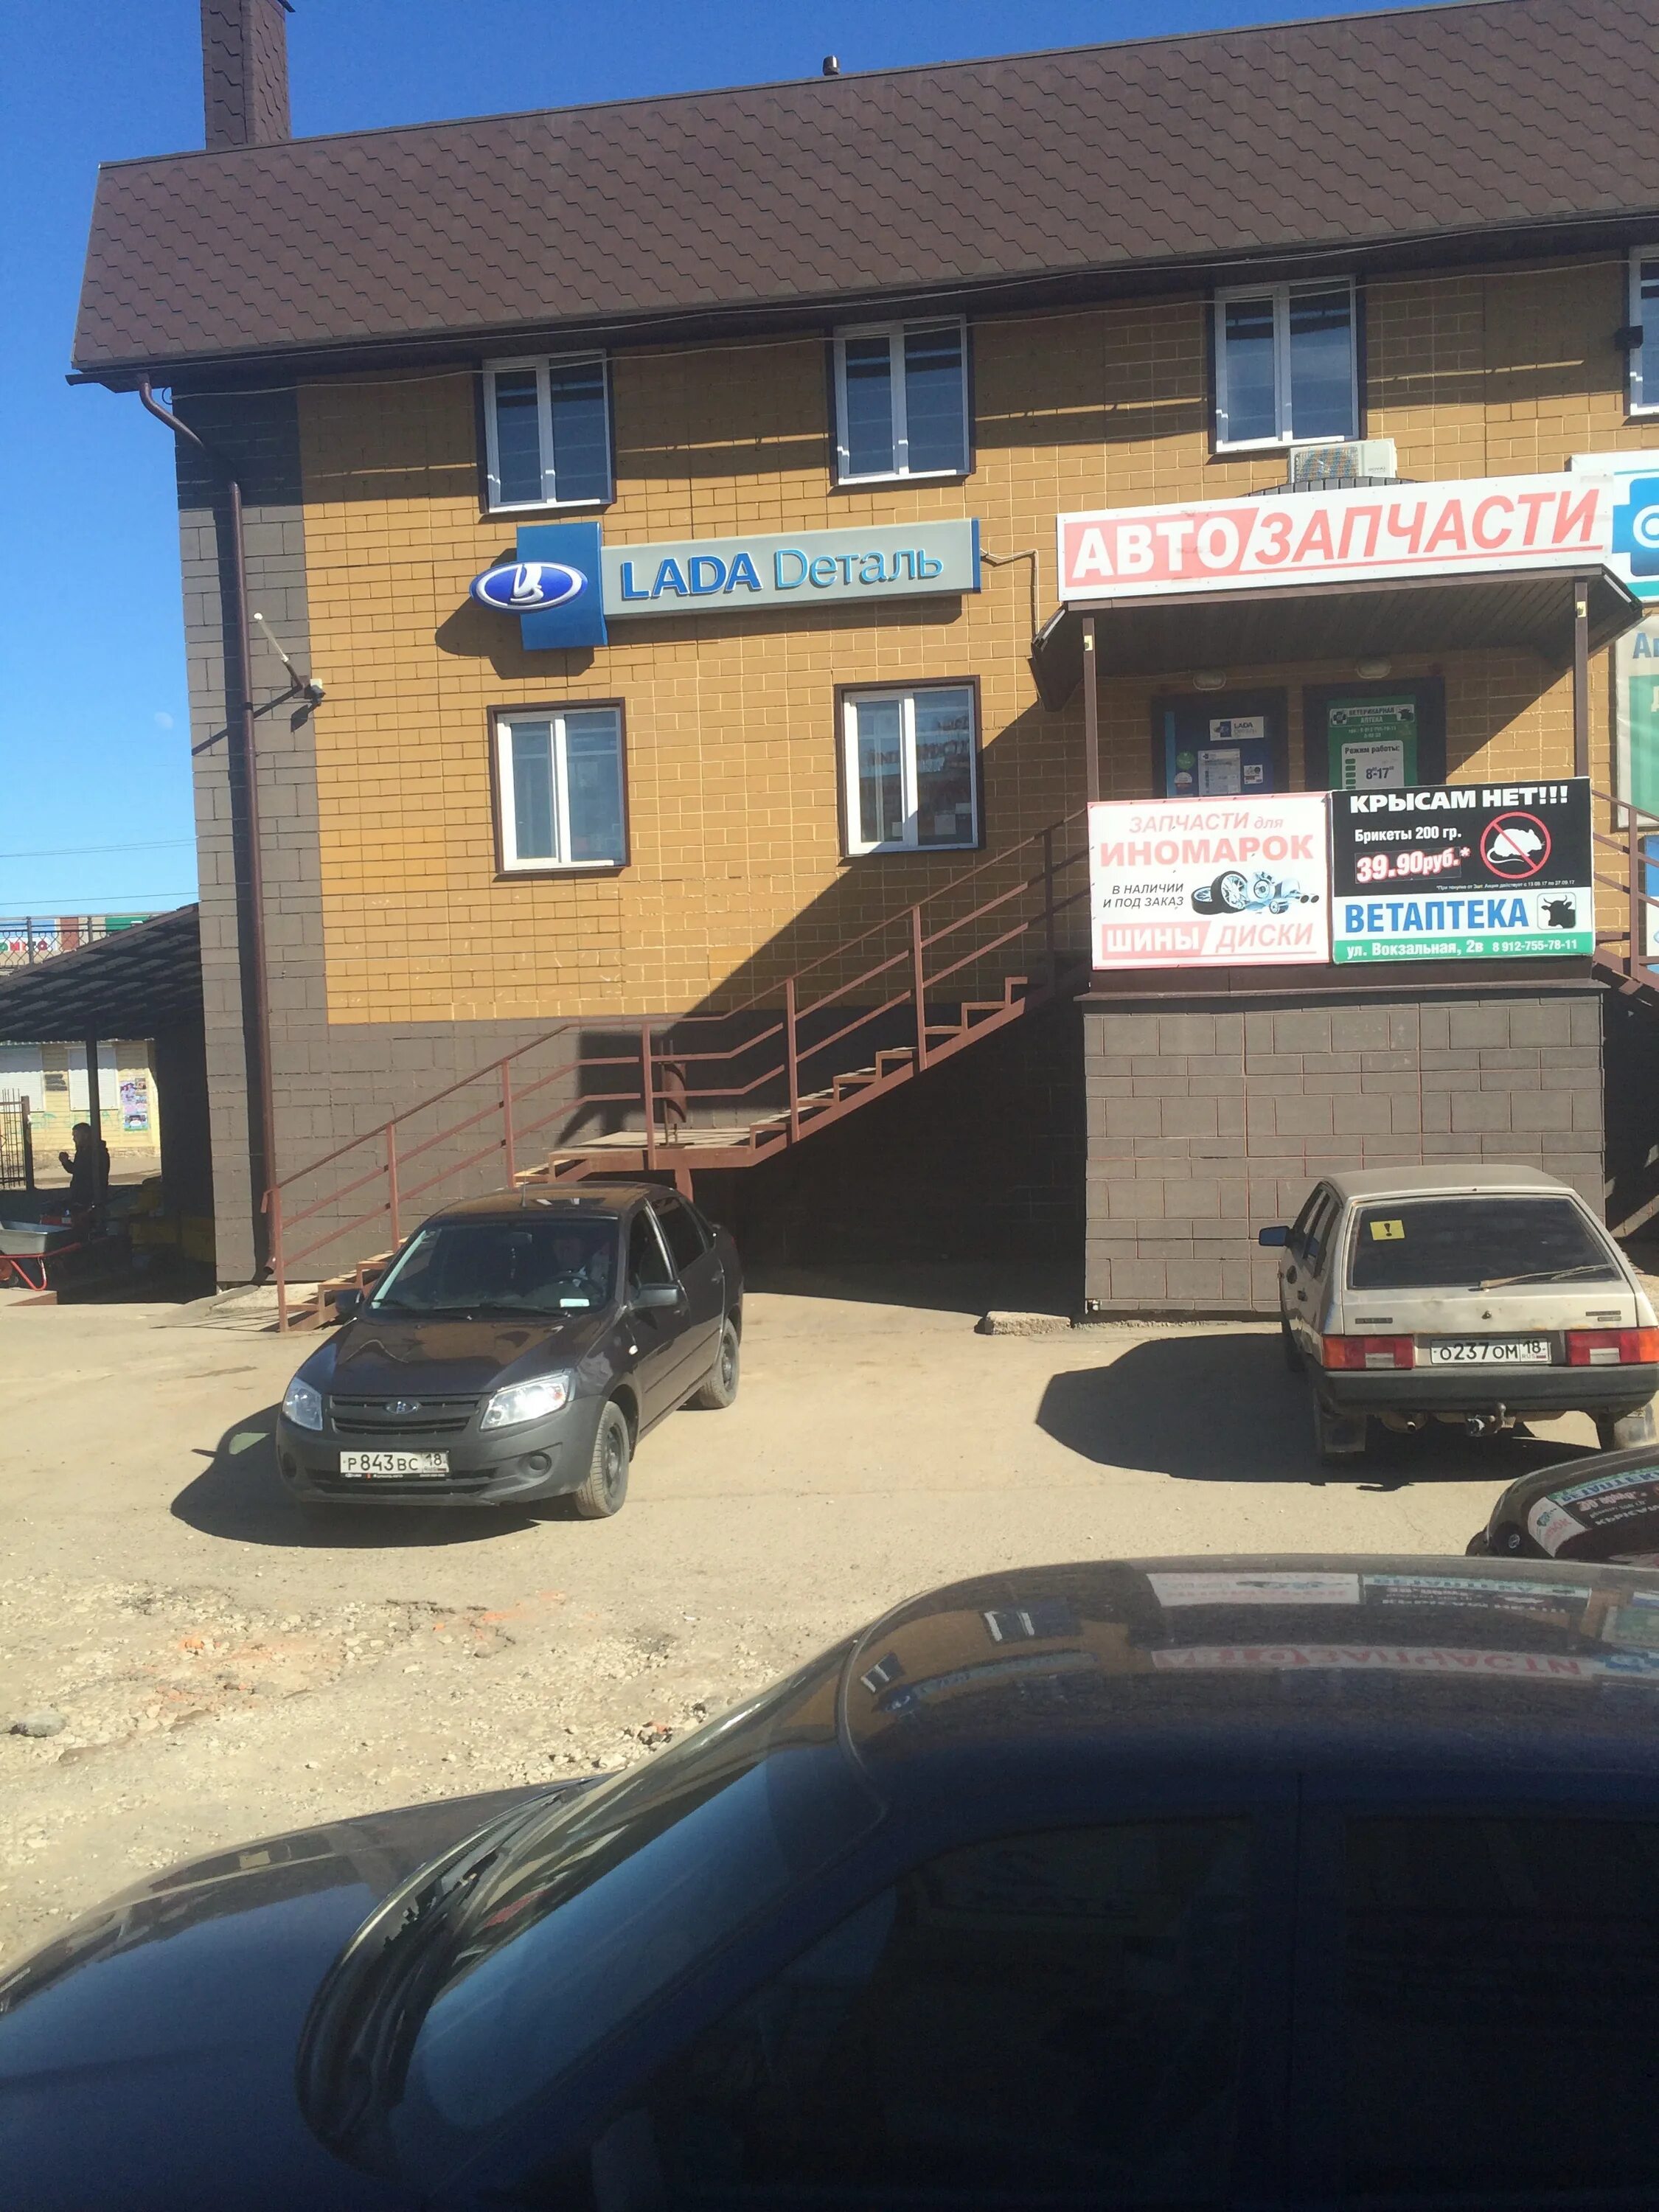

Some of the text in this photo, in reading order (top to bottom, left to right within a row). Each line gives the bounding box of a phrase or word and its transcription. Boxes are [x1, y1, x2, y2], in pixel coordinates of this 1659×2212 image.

[621, 552, 762, 600] LADA
[1234, 721, 1253, 729] LADA
[1371, 745, 1400, 754] работы:
[1349, 785, 1568, 814] КРЫСАМ НЕТ!!!
[1129, 812, 1284, 834] ЗАПЧАСТИ для
[1354, 826, 1462, 844] Брикеты 200 гр.
[1100, 834, 1314, 867] ИНОМАРОК
[1112, 883, 1184, 895] В НАЛИЧИИ
[1103, 896, 1184, 909] И ПОД ЗАКАЗ
[1345, 898, 1529, 933] ВЕТАПТЕКА
[1106, 922, 1314, 953] ШИНЫ ДИСКИ
[1346, 944, 1367, 960] ул.
[1466, 939, 1484, 954] 2в
[1492, 942, 1499, 953] 8
[1501, 939, 1578, 952] 912-755-78-11
[1523, 1340, 1542, 1354] 18
[425, 1453, 442, 1466] 18
